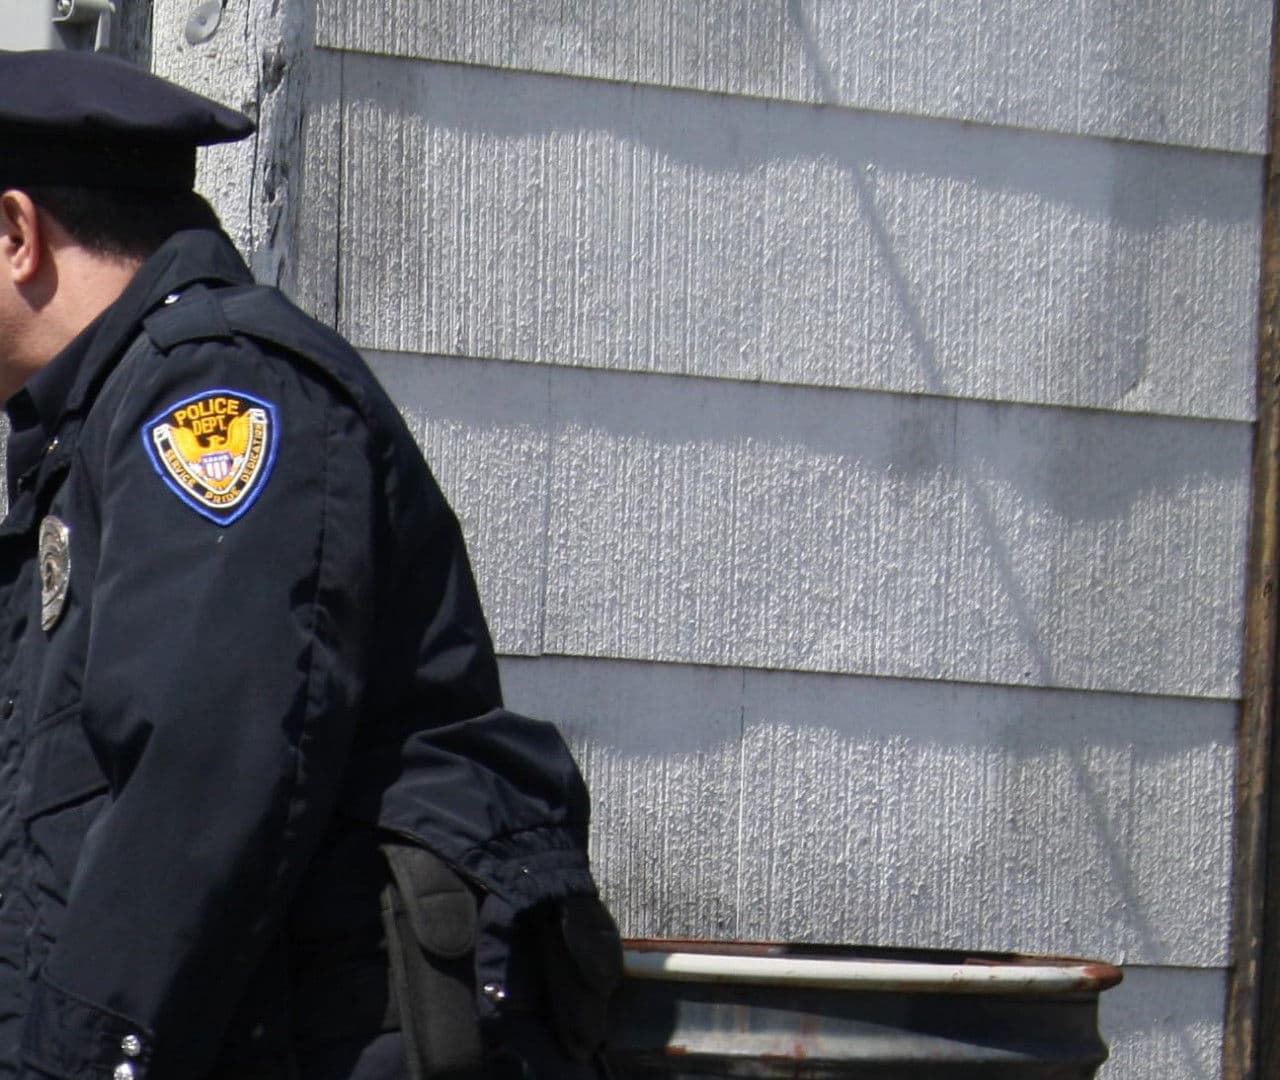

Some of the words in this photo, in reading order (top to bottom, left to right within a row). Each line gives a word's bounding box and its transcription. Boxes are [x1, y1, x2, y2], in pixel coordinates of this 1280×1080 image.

[174, 398, 240, 427] POLICE
[165, 448, 196, 489] SERVICE
[204, 487, 242, 504] PRIDE
[241, 423, 264, 484] DEDICATION
